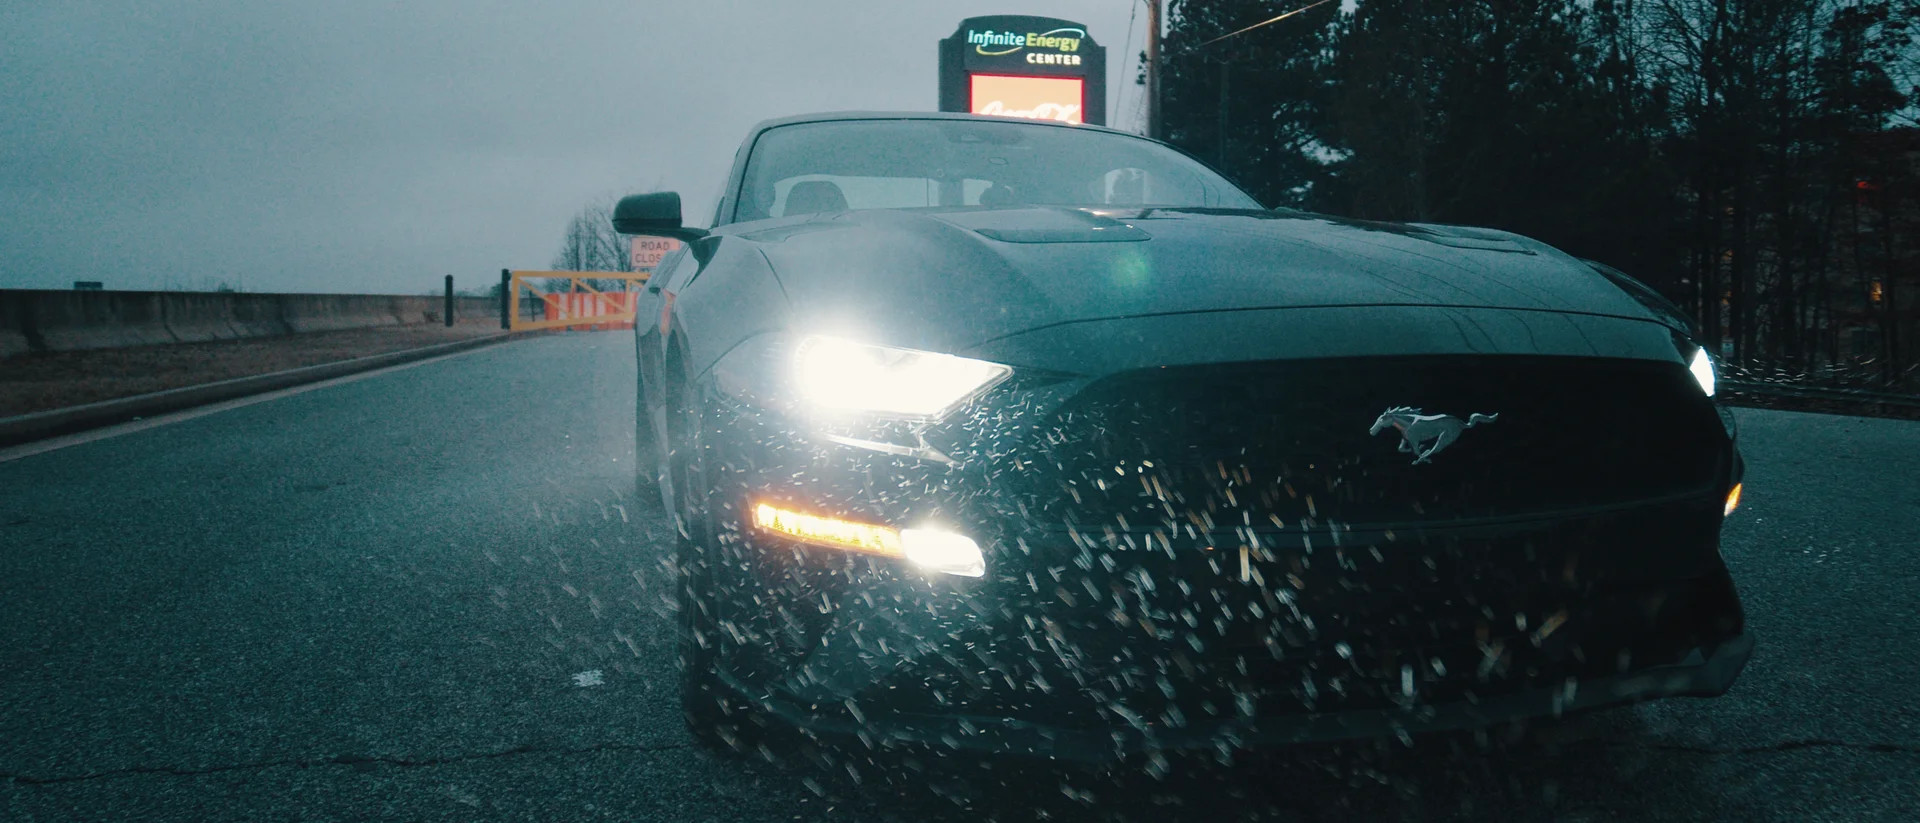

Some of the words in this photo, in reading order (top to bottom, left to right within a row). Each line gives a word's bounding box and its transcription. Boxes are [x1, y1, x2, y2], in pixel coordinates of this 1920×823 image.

[968, 29, 1025, 47] Infinite
[1026, 33, 1080, 51] Energy
[1026, 53, 1081, 65] CENTER
[641, 241, 670, 251] ROAD
[635, 253, 661, 263] CLOS
